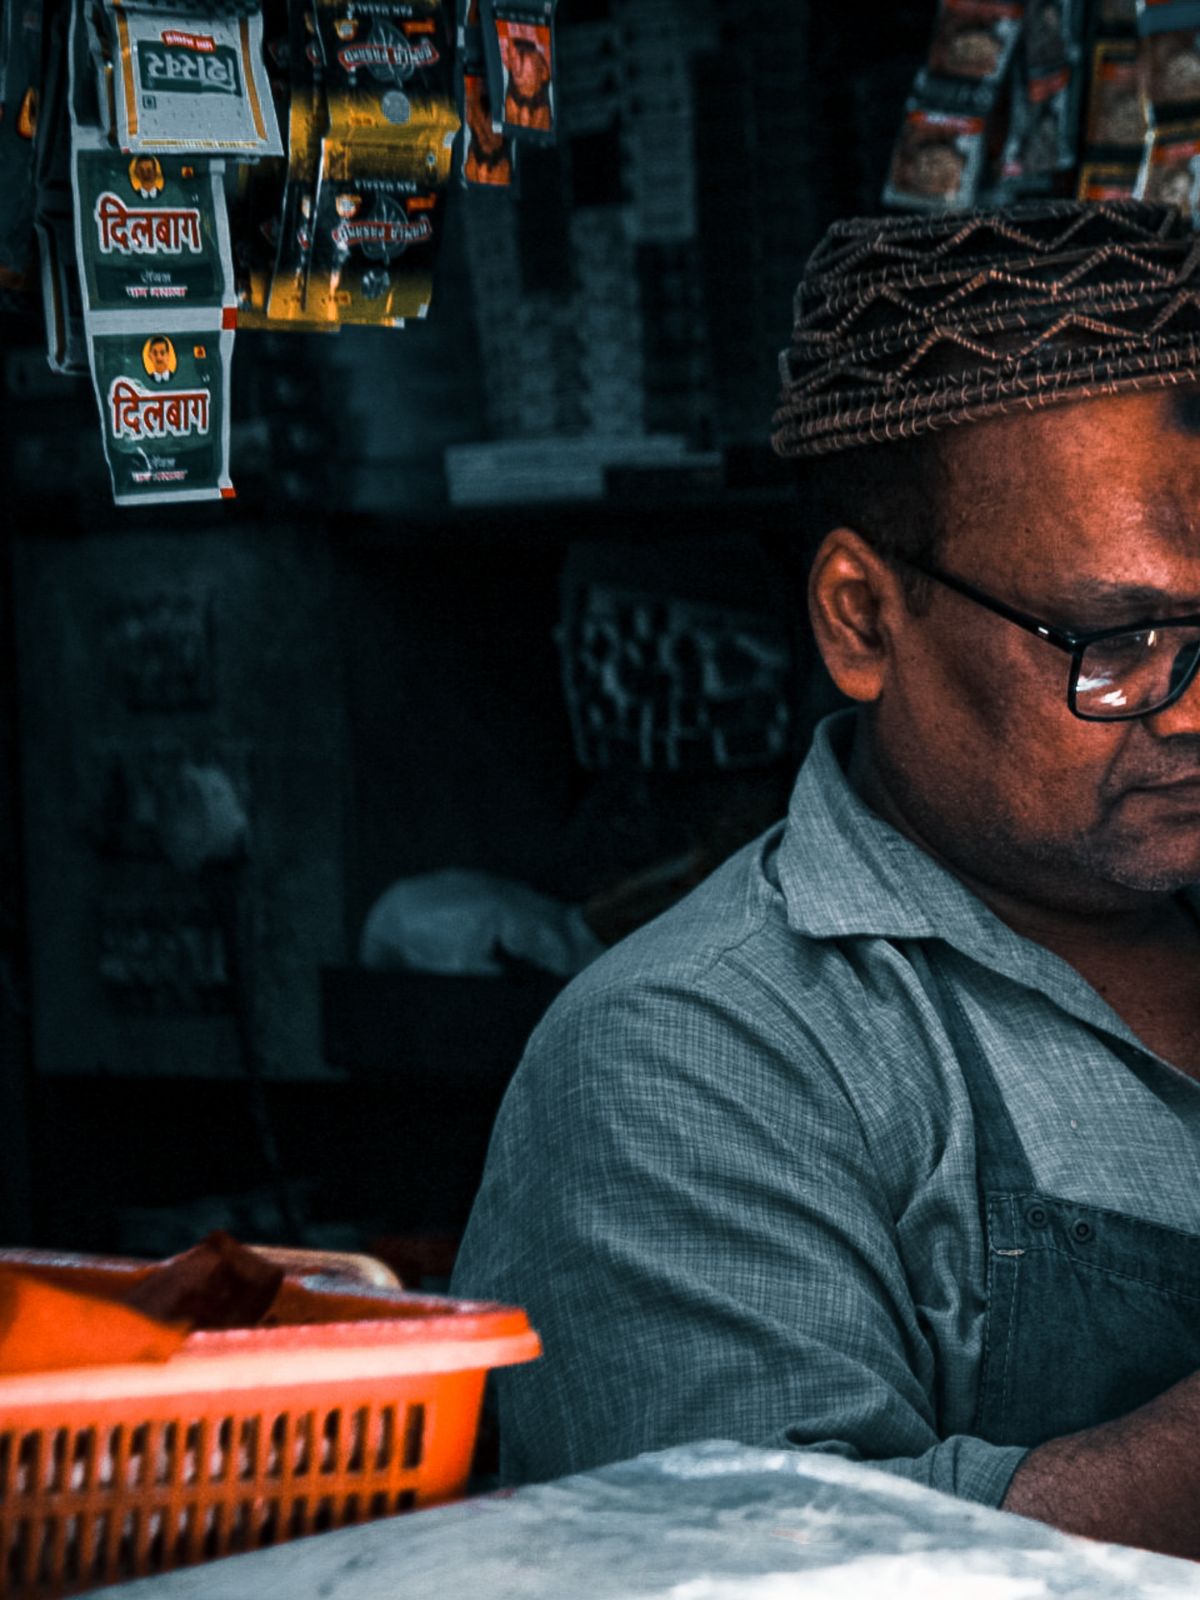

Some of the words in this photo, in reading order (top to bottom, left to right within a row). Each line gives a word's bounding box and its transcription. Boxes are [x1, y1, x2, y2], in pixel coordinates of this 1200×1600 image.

[145, 52, 237, 92] शिखर
[96, 193, 201, 252] दिलबाग
[109, 378, 209, 438] दिलबाग
